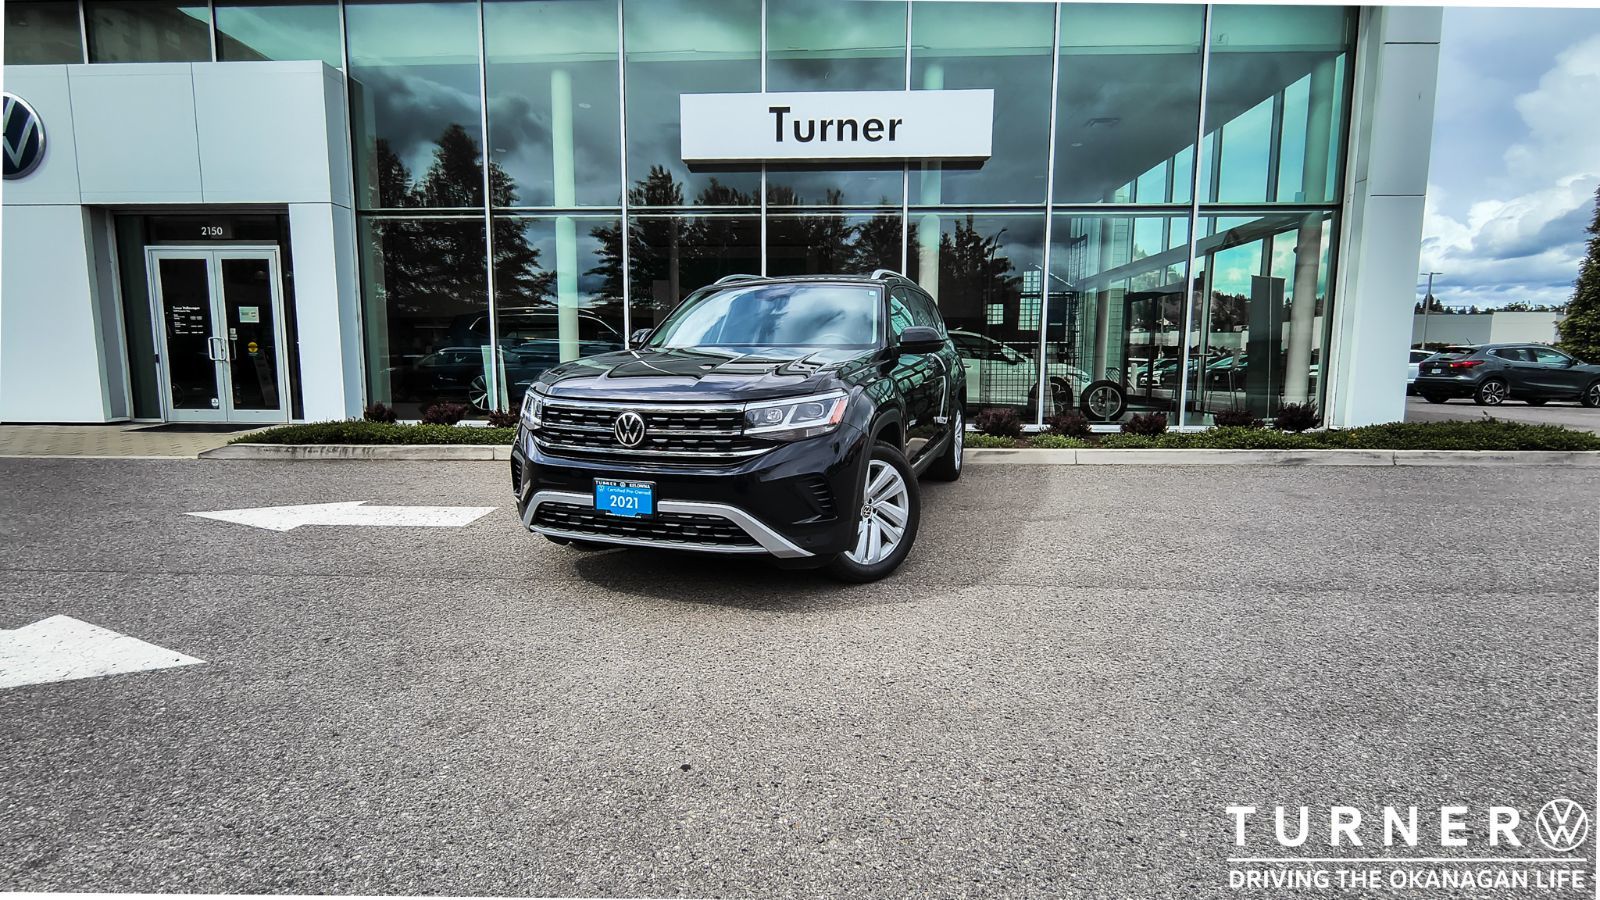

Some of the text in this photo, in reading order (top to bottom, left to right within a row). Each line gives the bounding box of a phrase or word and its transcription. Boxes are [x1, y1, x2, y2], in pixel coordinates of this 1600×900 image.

[768, 106, 903, 143] Turner
[201, 226, 223, 236] 2150
[610, 494, 639, 509] 2021
